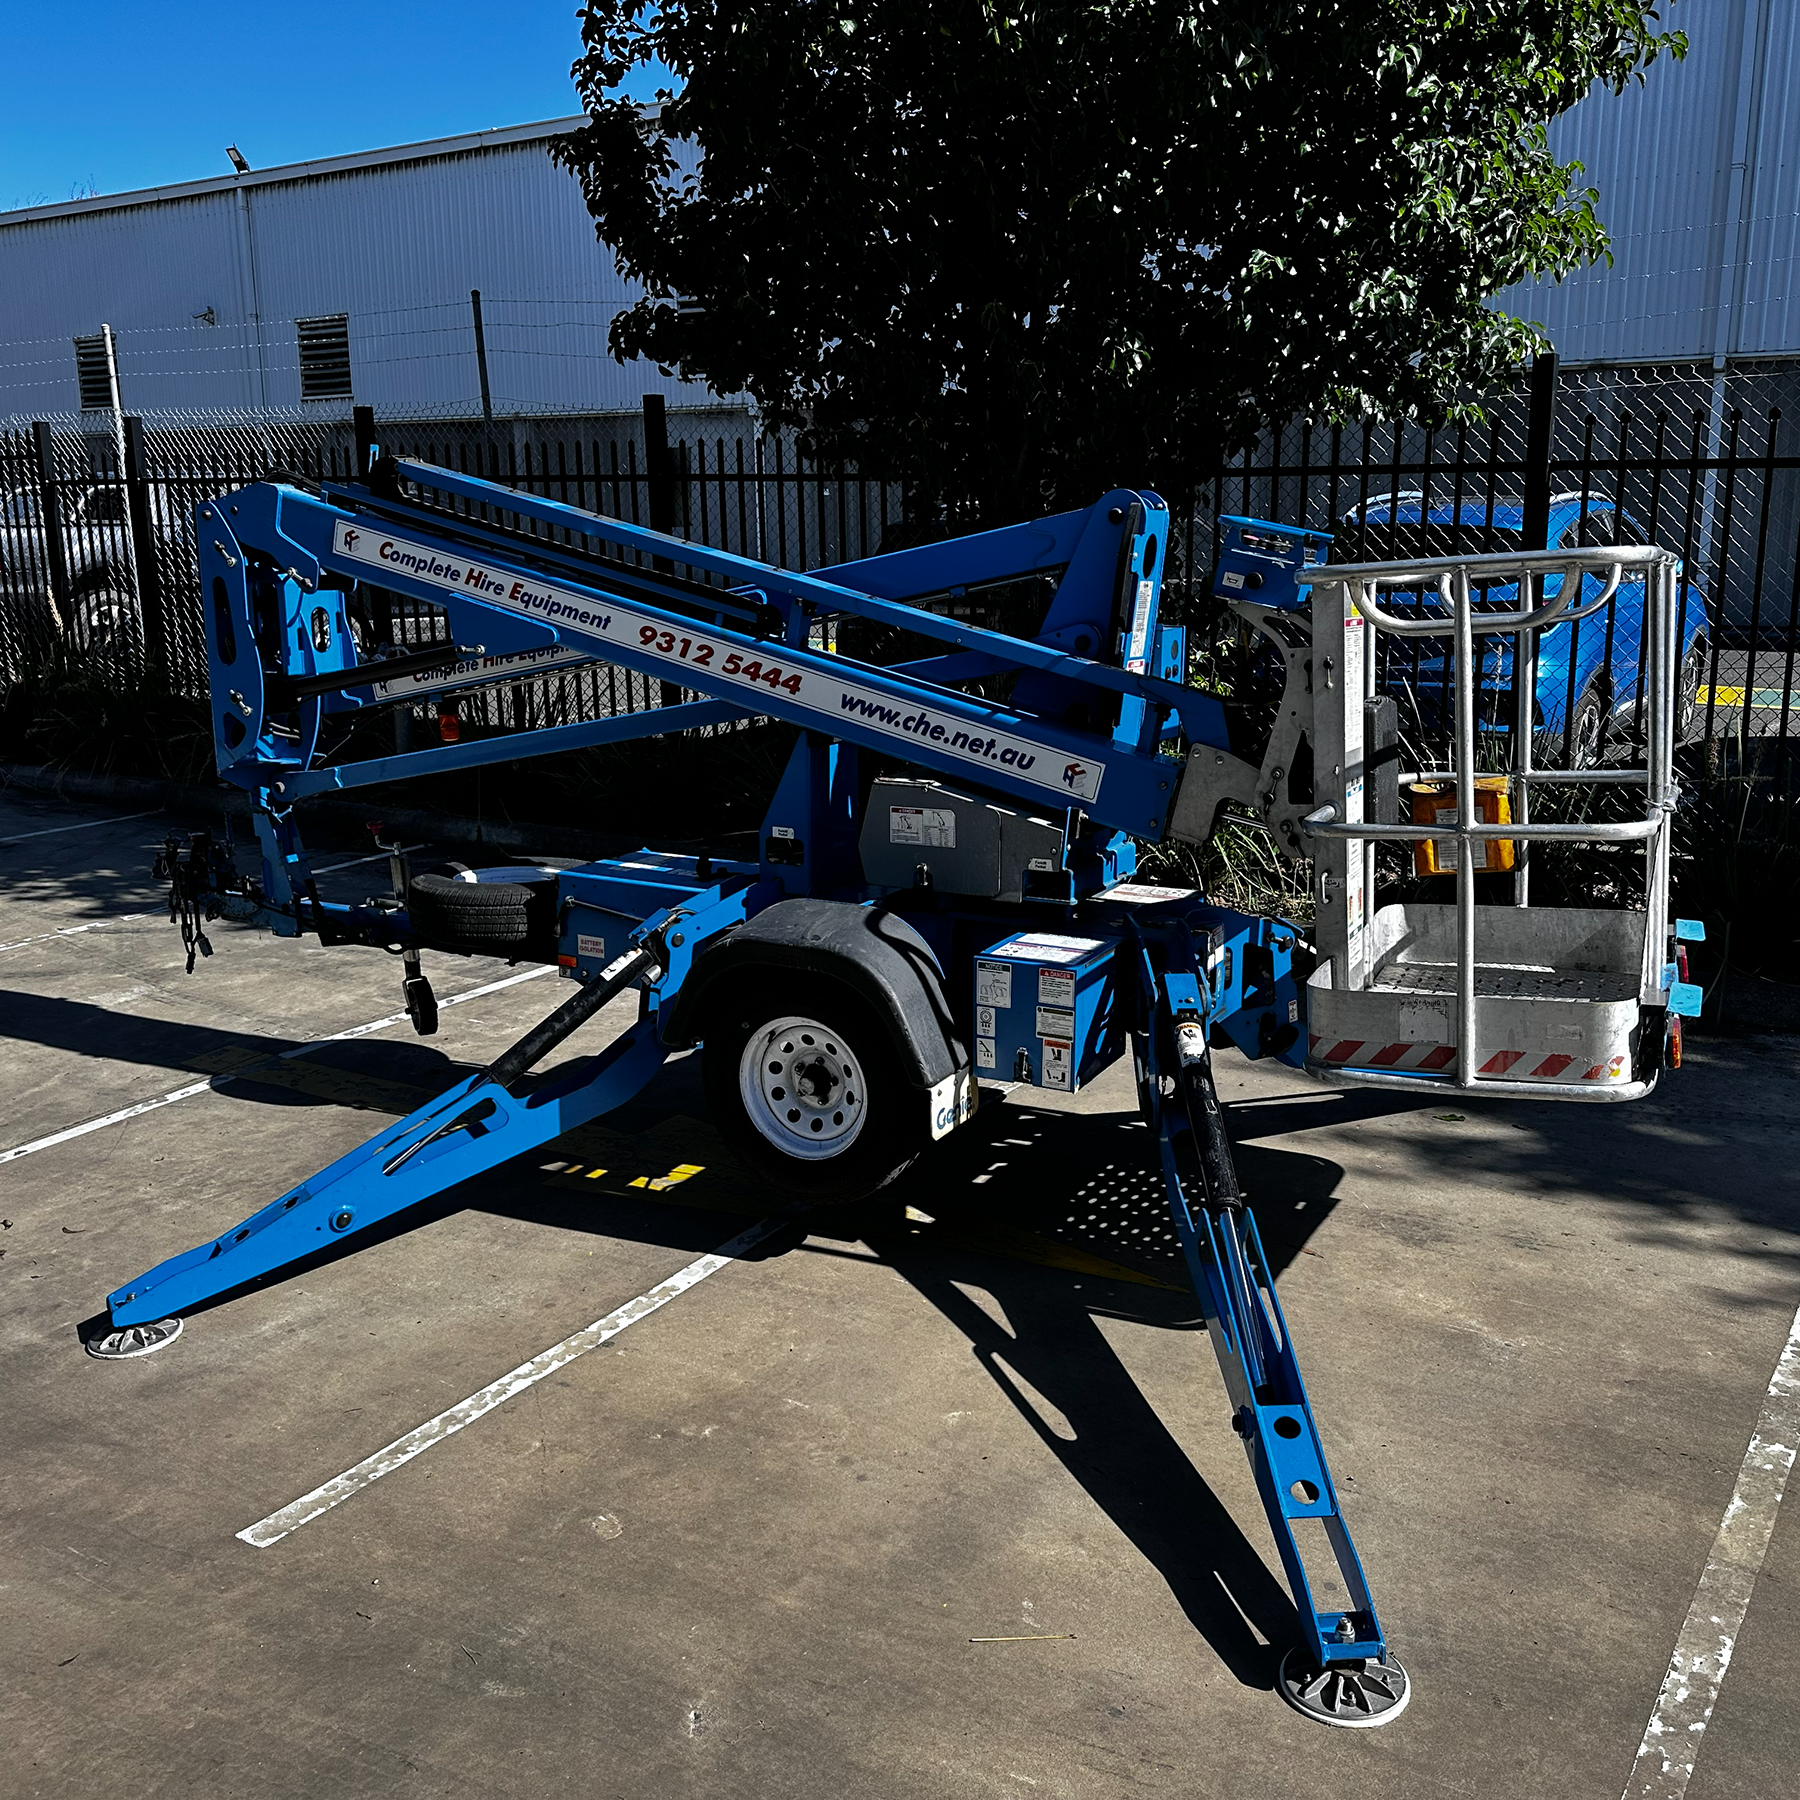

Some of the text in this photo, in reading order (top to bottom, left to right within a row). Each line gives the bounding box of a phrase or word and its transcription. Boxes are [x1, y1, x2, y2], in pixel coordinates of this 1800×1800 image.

[379, 541, 612, 631] Complete Hire Equipment
[638, 624, 802, 696] 9312 5444
[840, 692, 1036, 771] www.che.net.au
[579, 945, 604, 954] ISOLATION
[580, 938, 602, 947] BATTERY
[985, 963, 1003, 971] NOTICE
[1049, 971, 1071, 979] DANGER
[936, 1095, 973, 1130] Genie
